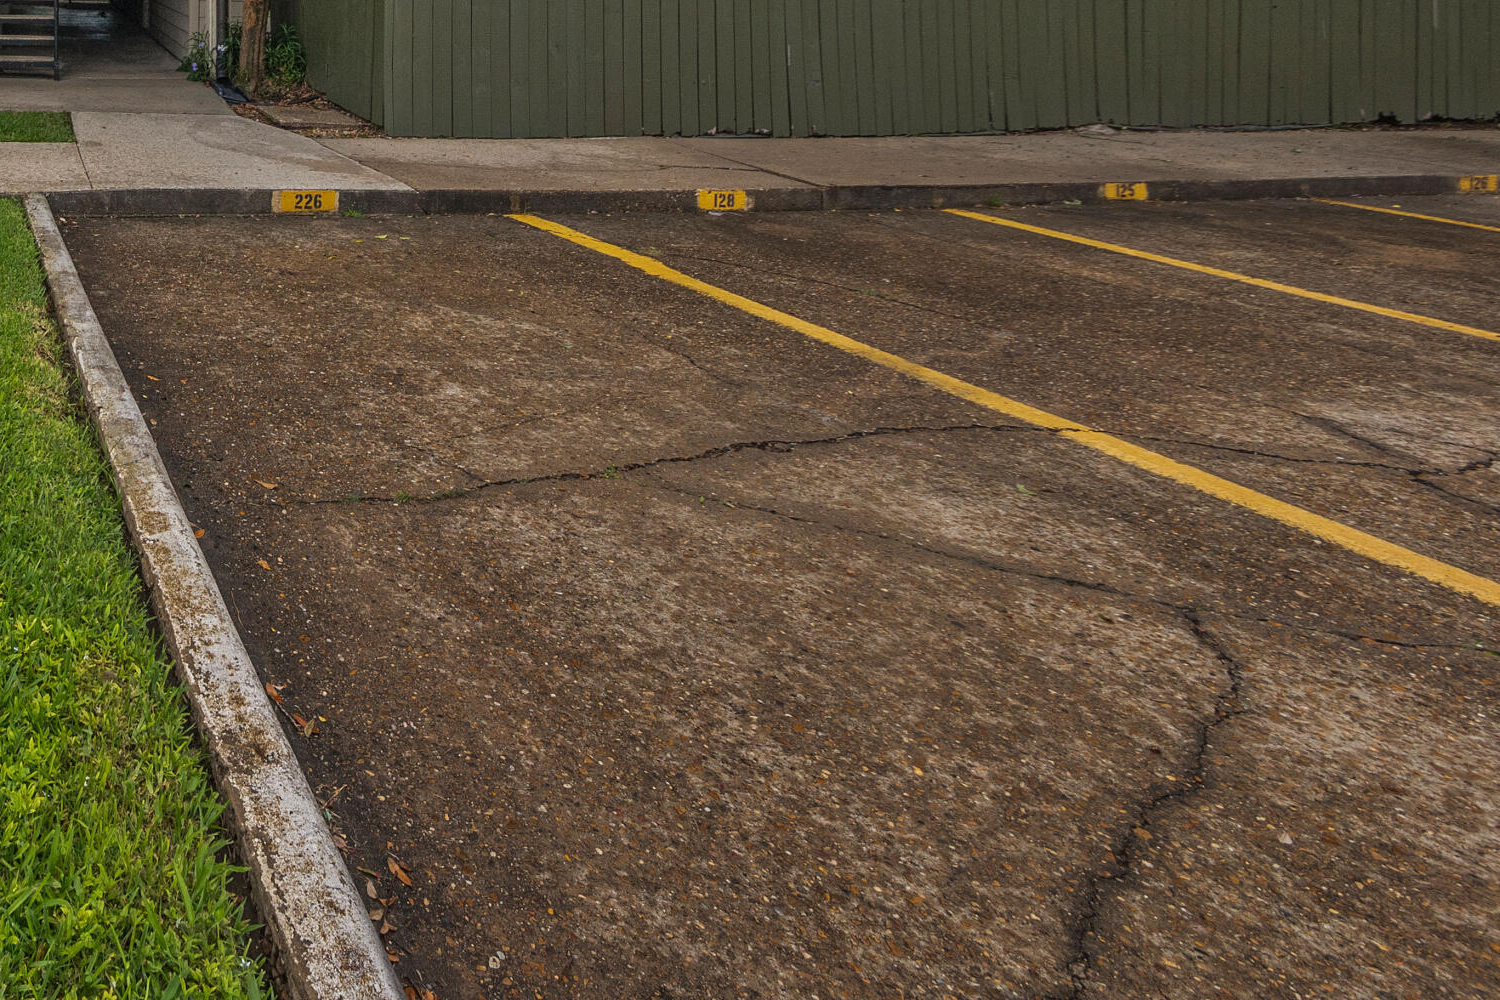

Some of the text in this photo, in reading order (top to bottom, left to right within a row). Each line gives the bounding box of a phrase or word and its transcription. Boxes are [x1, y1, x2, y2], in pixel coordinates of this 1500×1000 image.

[1116, 183, 1135, 197] 125
[294, 193, 322, 209] 226
[714, 193, 735, 208] 128
